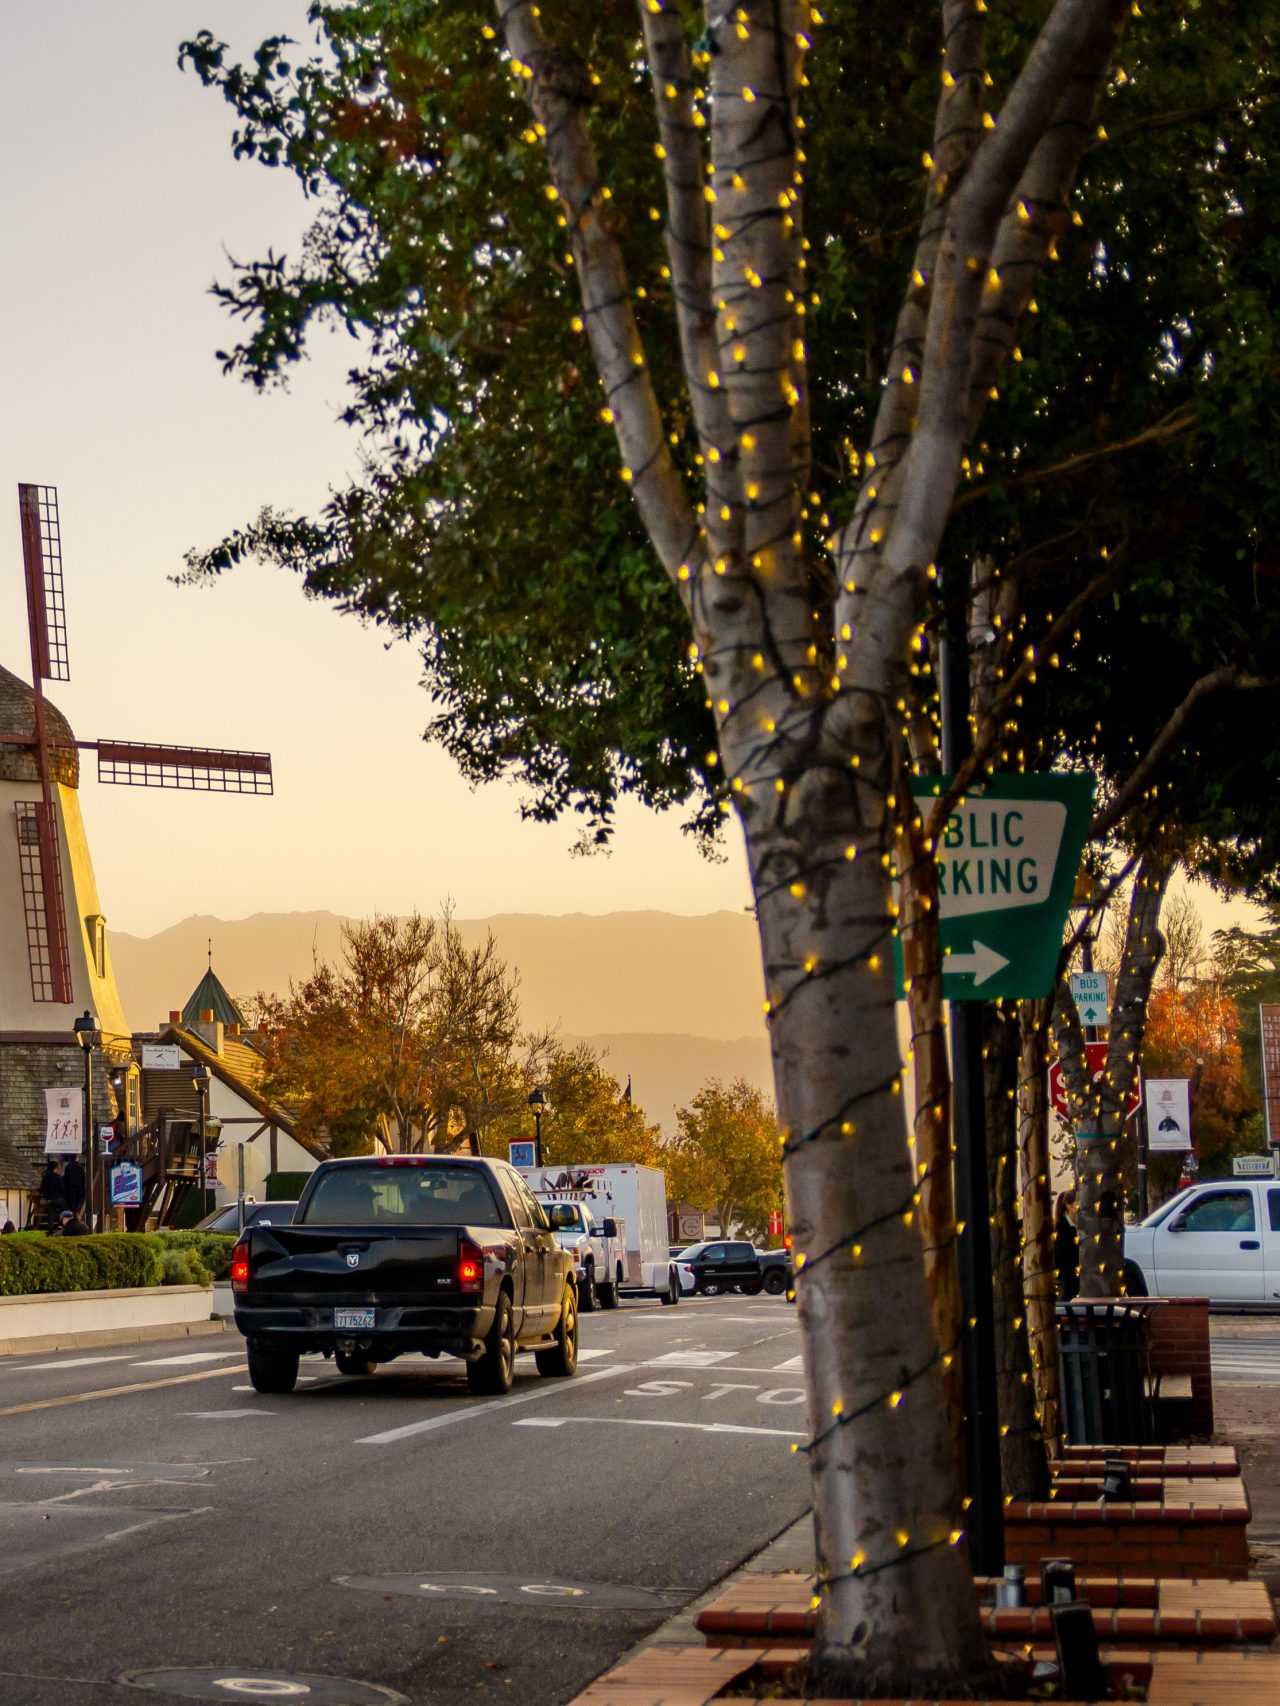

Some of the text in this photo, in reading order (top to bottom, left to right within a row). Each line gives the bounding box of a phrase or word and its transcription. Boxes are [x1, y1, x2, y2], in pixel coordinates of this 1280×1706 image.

[943, 810, 1025, 848] BLIC
[936, 857, 1038, 896] RKING
[1079, 979, 1099, 989] BUS
[1074, 992, 1106, 1002] PARKING
[623, 1380, 808, 1405] STO
